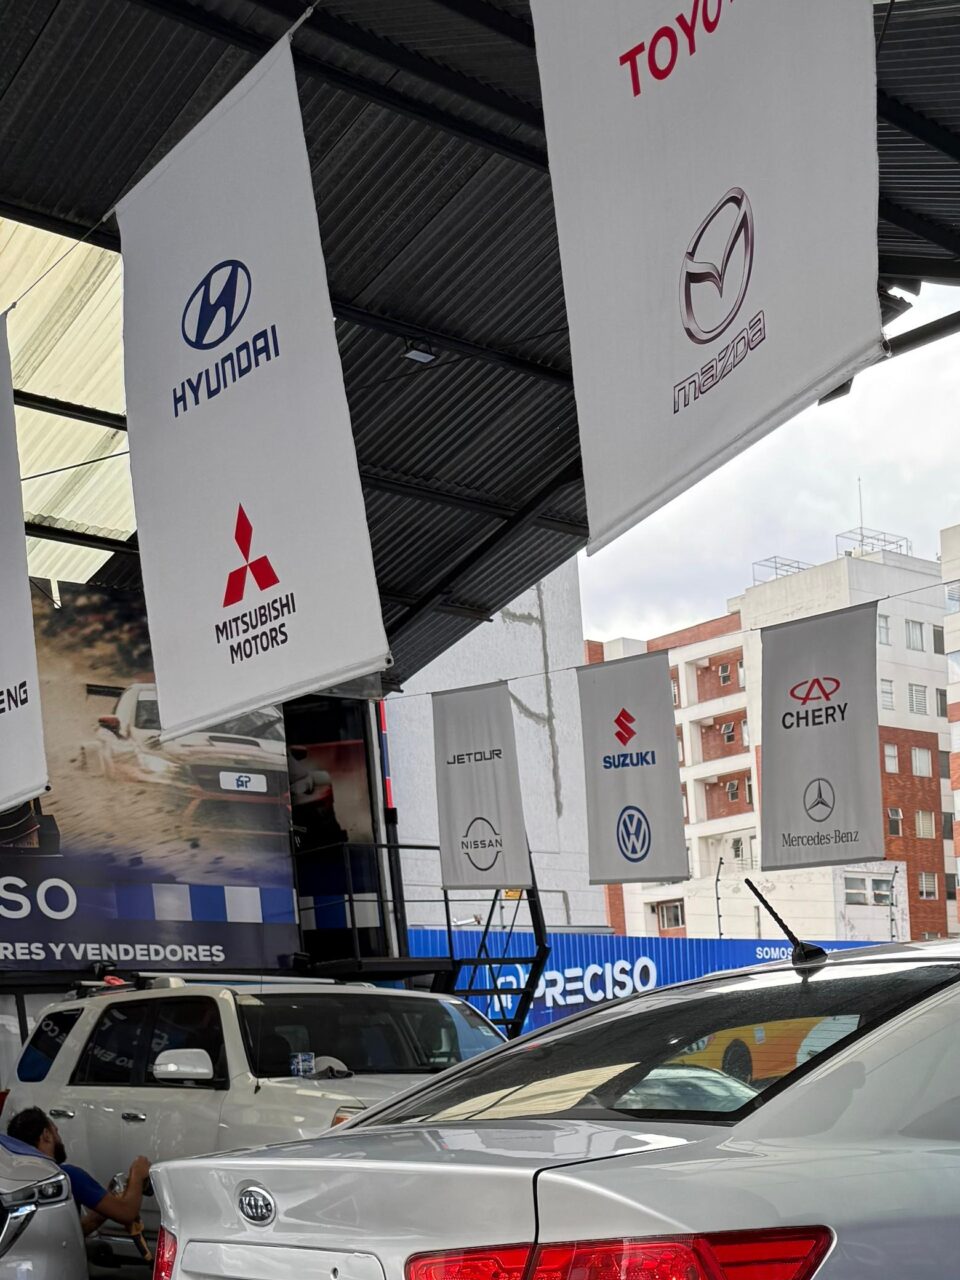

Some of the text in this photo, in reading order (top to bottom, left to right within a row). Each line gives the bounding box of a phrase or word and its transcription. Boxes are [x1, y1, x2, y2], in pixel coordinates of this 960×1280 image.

[619, 0, 734, 97] TOYO
[172, 324, 280, 418] HYUNDAI
[215, 592, 296, 644] MITSUBISHI
[229, 623, 289, 665] MOTORS
[782, 702, 848, 729] CHERY
[446, 748, 502, 765] JETOUR
[603, 750, 656, 770] SUZUKI
[461, 838, 503, 850] NISSAN
[782, 829, 859, 847] Mercedes-Benz
[0, 875, 77, 920] SO
[0, 942, 225, 962] RES Y VENDEDORES
[756, 946, 793, 960] SOMOS
[242, 1196, 270, 1217] KIA
